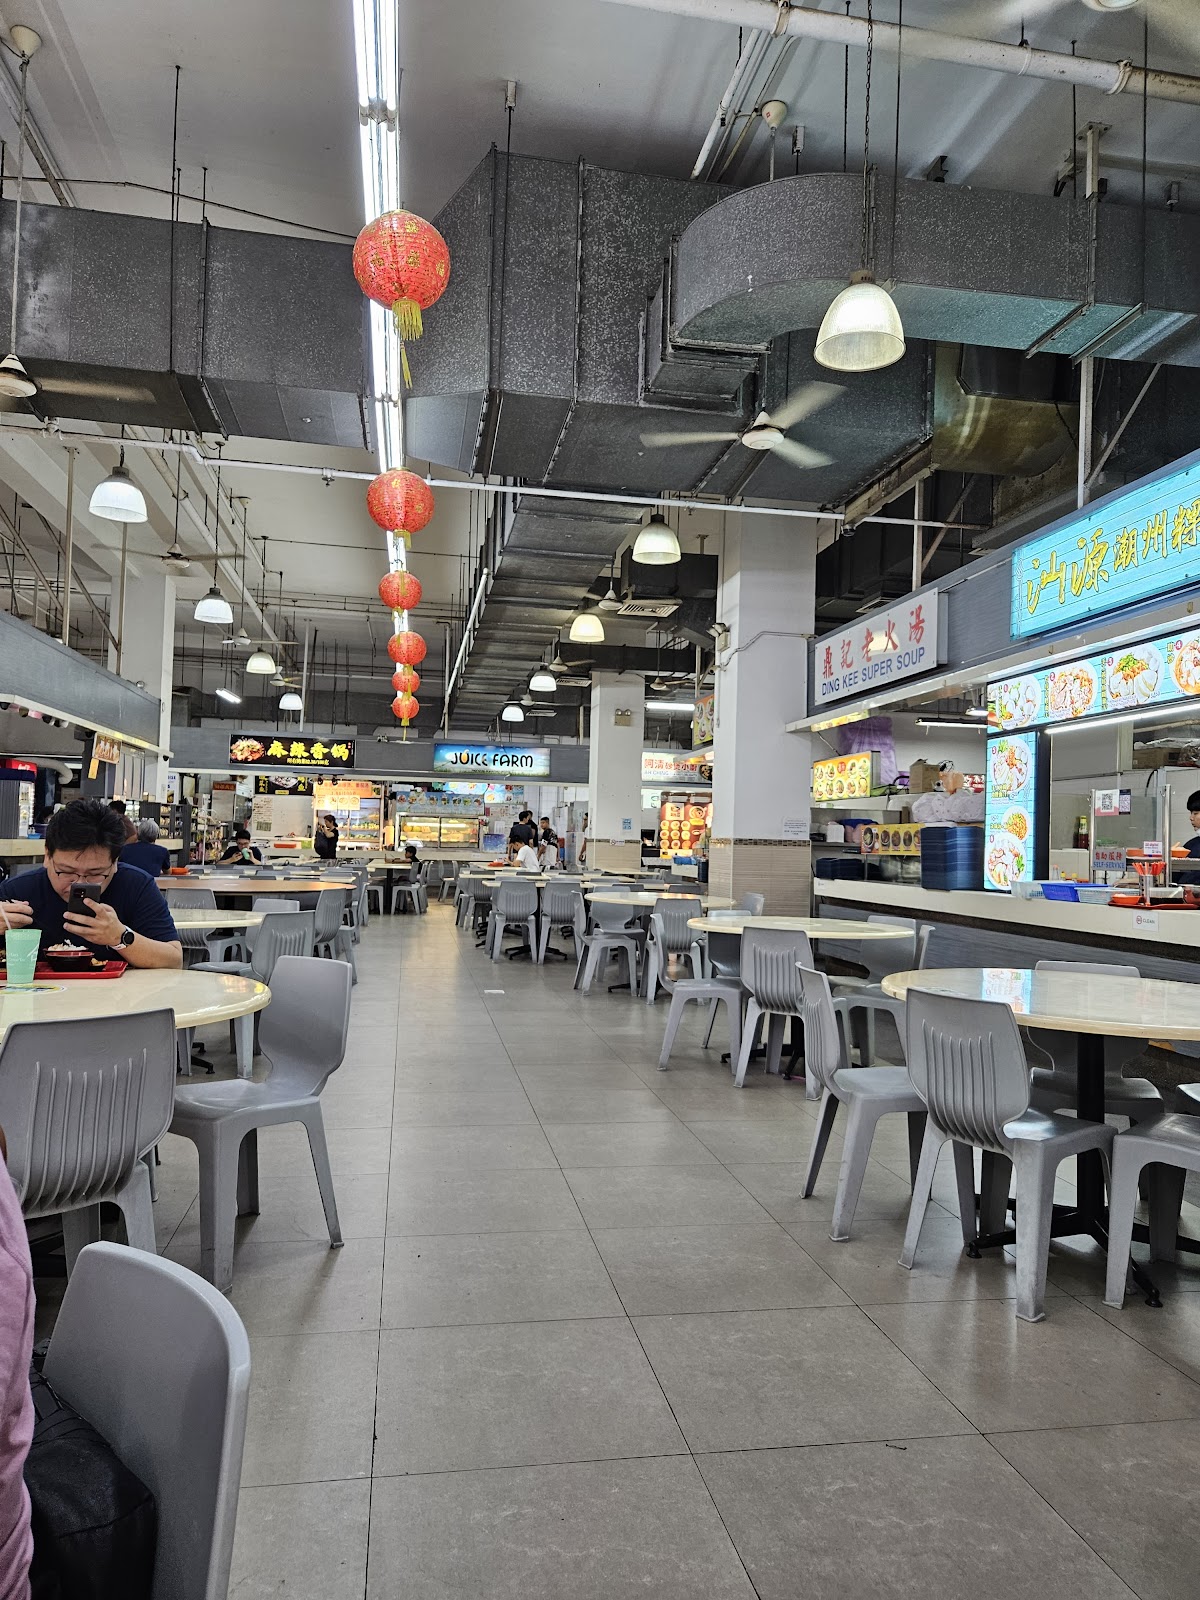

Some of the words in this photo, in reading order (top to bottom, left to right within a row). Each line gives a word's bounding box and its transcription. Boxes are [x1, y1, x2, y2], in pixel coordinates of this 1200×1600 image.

[822, 604, 925, 679] 鼎記老火湯
[822, 678, 840, 696] DING
[842, 670, 859, 689] KEE
[862, 658, 893, 682] SUPER
[896, 646, 925, 670] SOUP
[451, 750, 488, 766] JUICE
[493, 753, 533, 768] FARM
[1093, 861, 1125, 869] SELF-SERVICE
